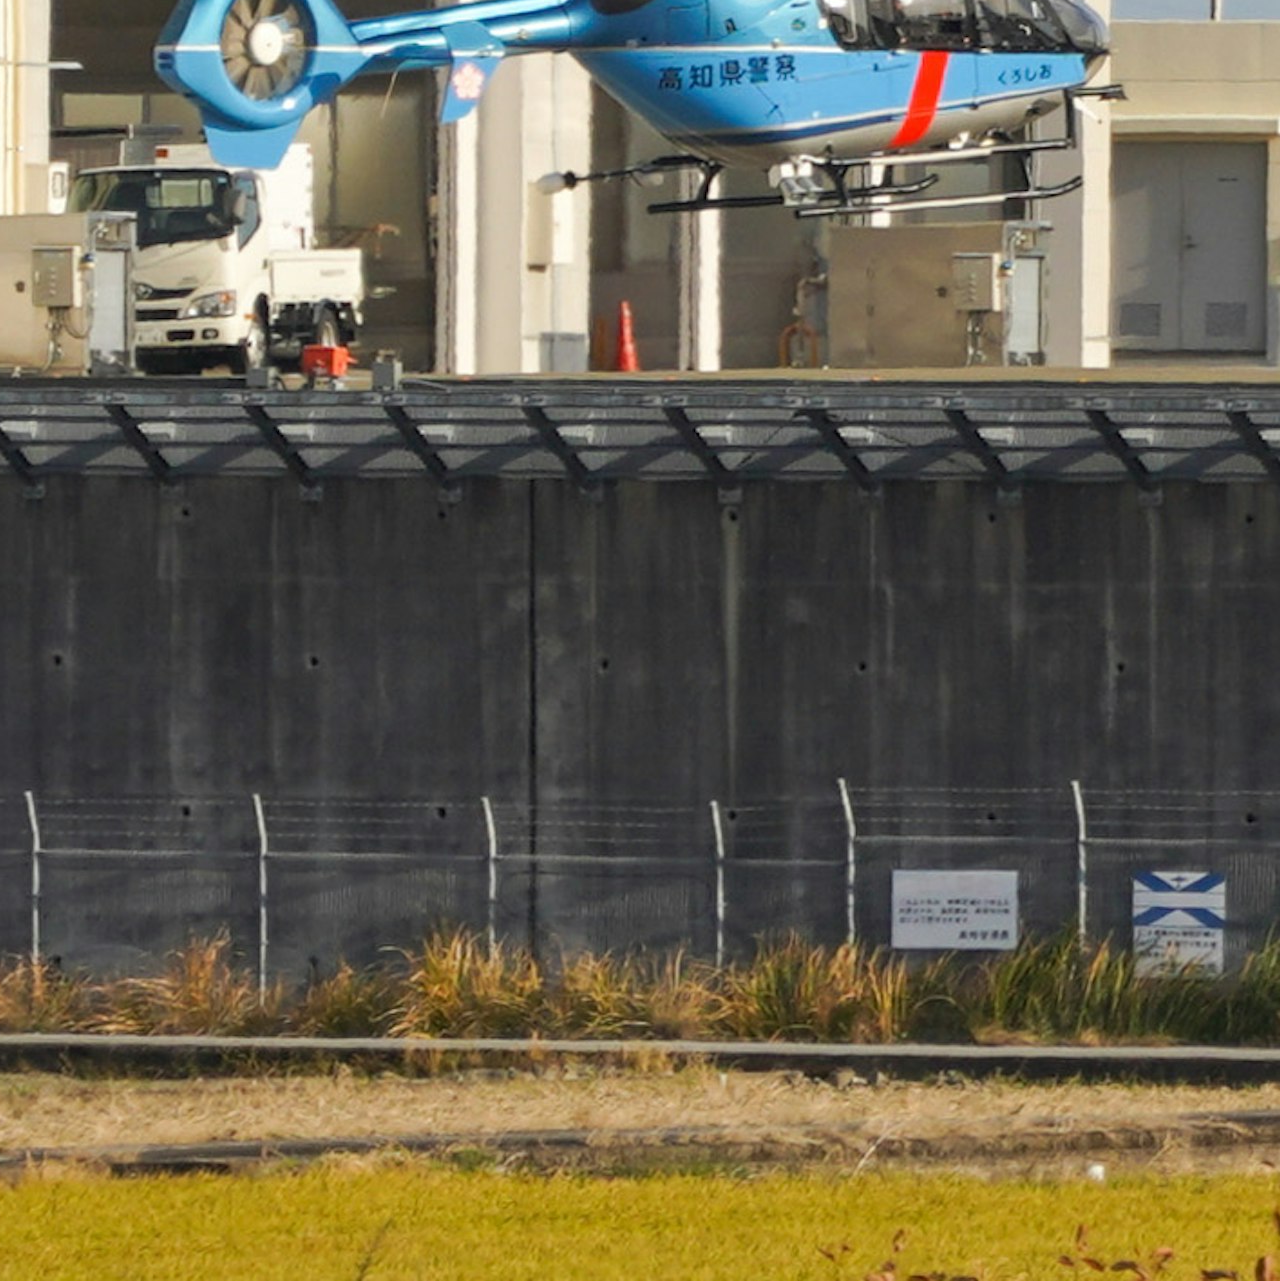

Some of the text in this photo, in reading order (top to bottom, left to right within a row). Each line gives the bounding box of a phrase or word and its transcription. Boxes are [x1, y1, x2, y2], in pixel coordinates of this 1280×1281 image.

[658, 54, 796, 90] 高知県警察
[997, 64, 1052, 85] くろしお
